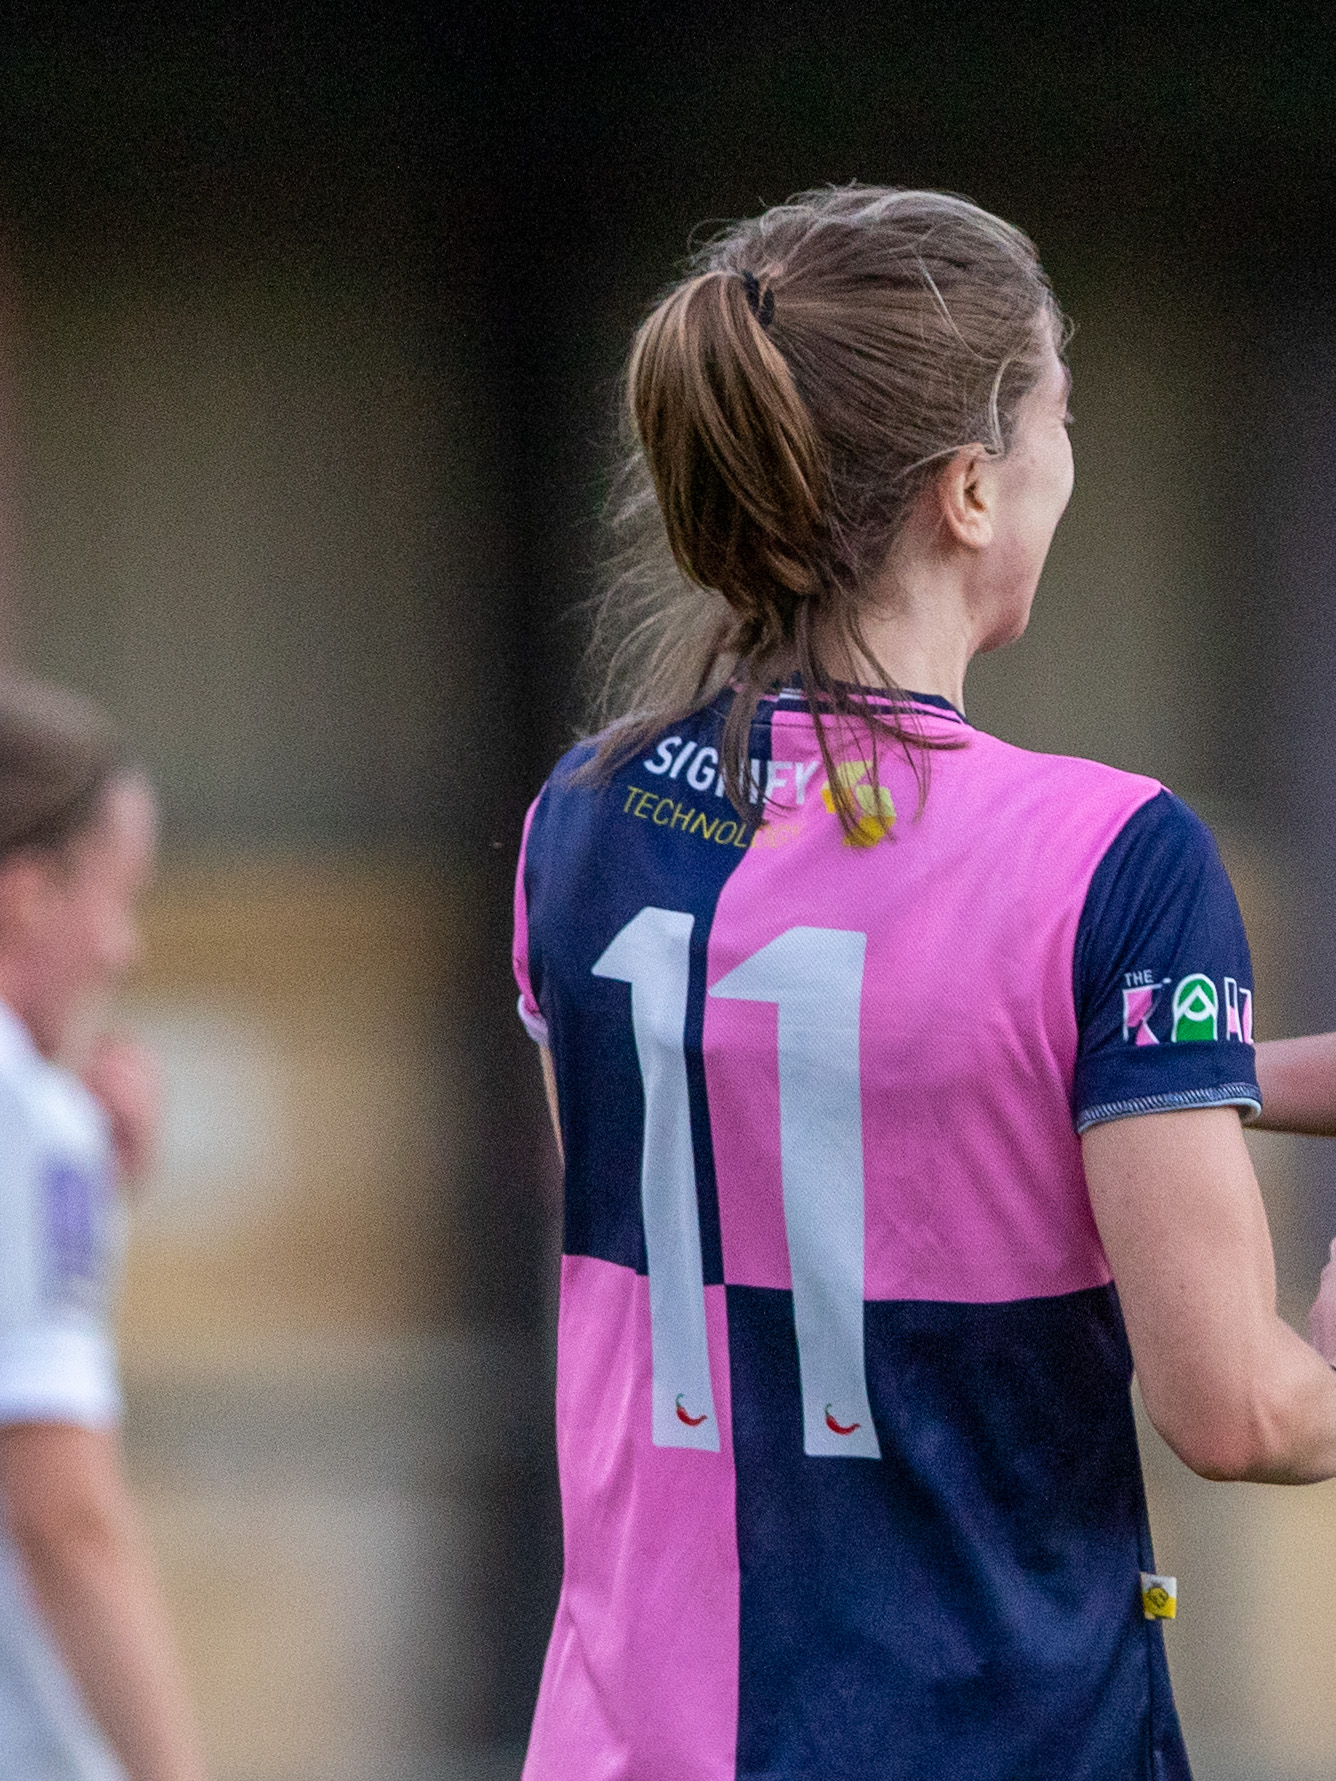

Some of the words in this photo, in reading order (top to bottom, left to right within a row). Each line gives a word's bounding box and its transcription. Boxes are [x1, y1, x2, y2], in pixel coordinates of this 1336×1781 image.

[627, 785, 799, 849] TECHNOL
[1123, 969, 1154, 988] THE
[591, 906, 882, 1460] 11
